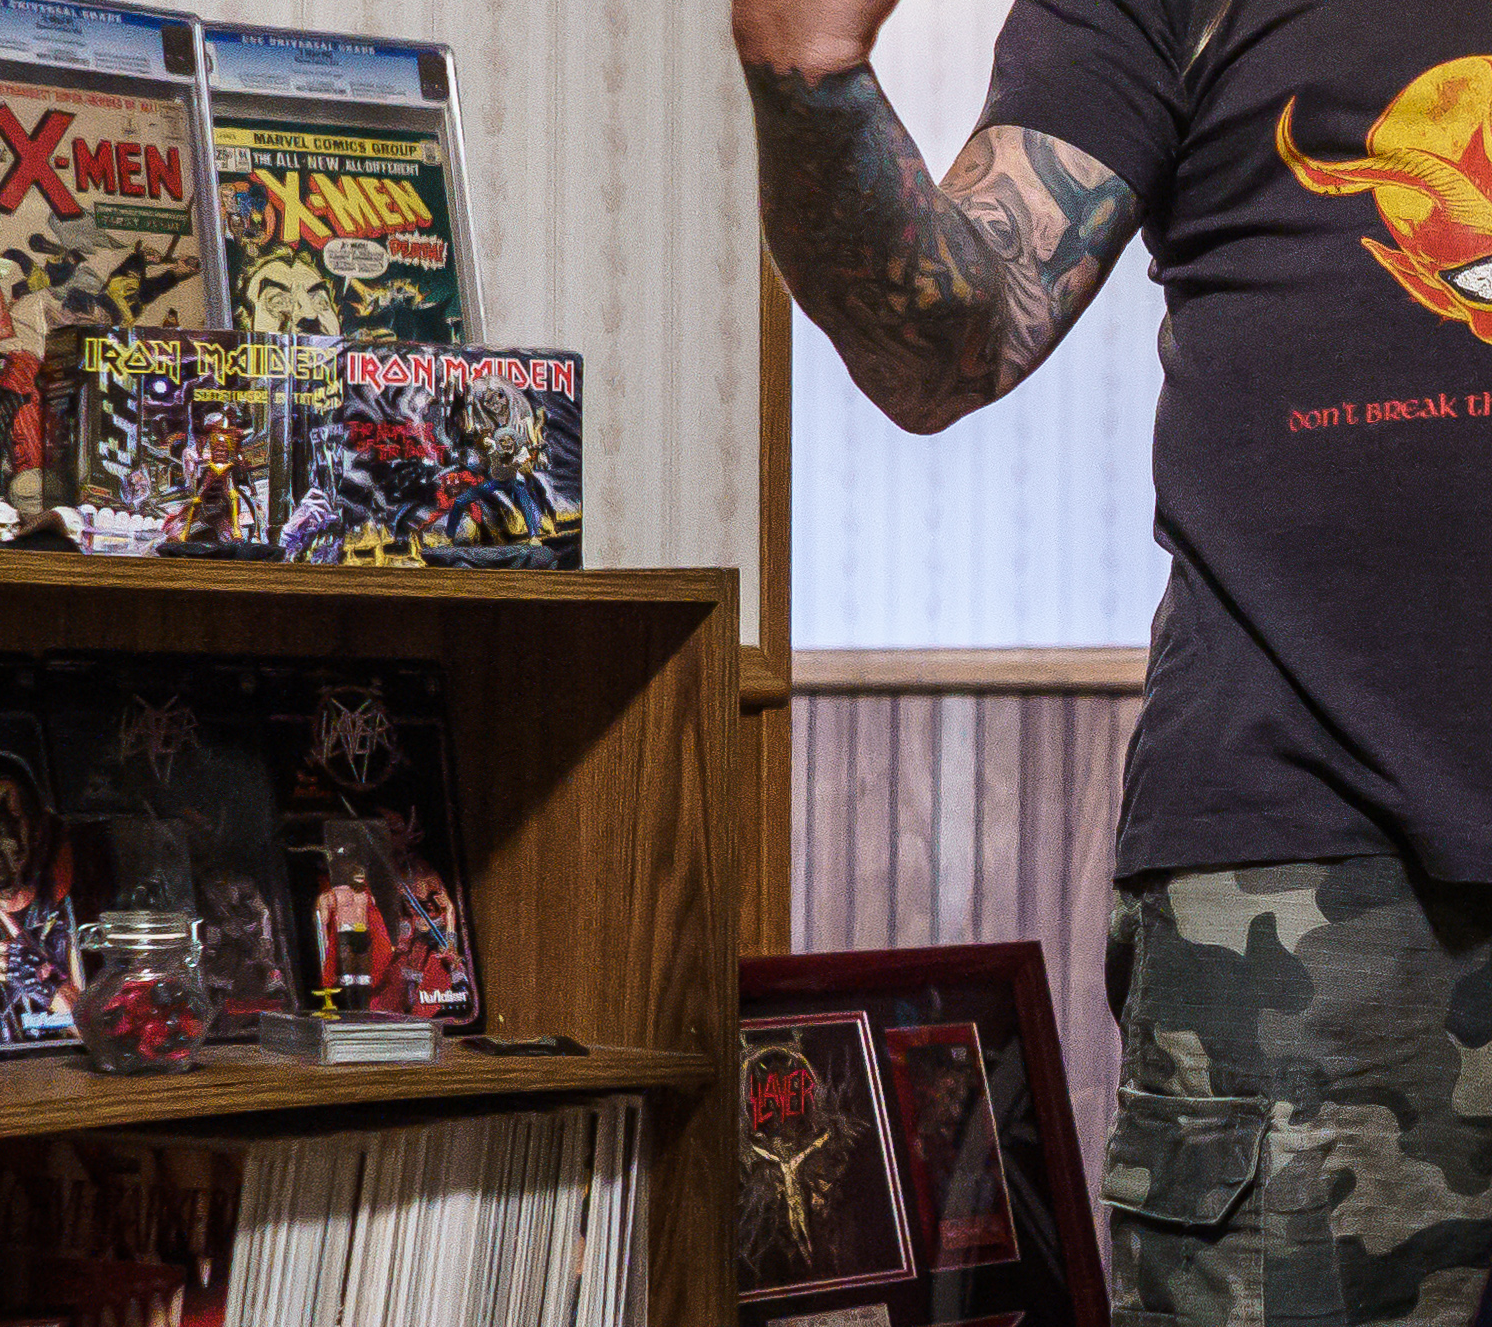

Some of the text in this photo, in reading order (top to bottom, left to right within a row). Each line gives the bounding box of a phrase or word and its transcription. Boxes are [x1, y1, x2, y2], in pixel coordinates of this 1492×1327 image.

[253, 132, 309, 149] MARVEL
[314, 137, 367, 155] COMICS
[371, 142, 418, 157] GROUP
[250, 168, 434, 251] X-MEN
[84, 337, 339, 386] IRON MAIDEN
[347, 351, 576, 402] IRON MAIDEN
